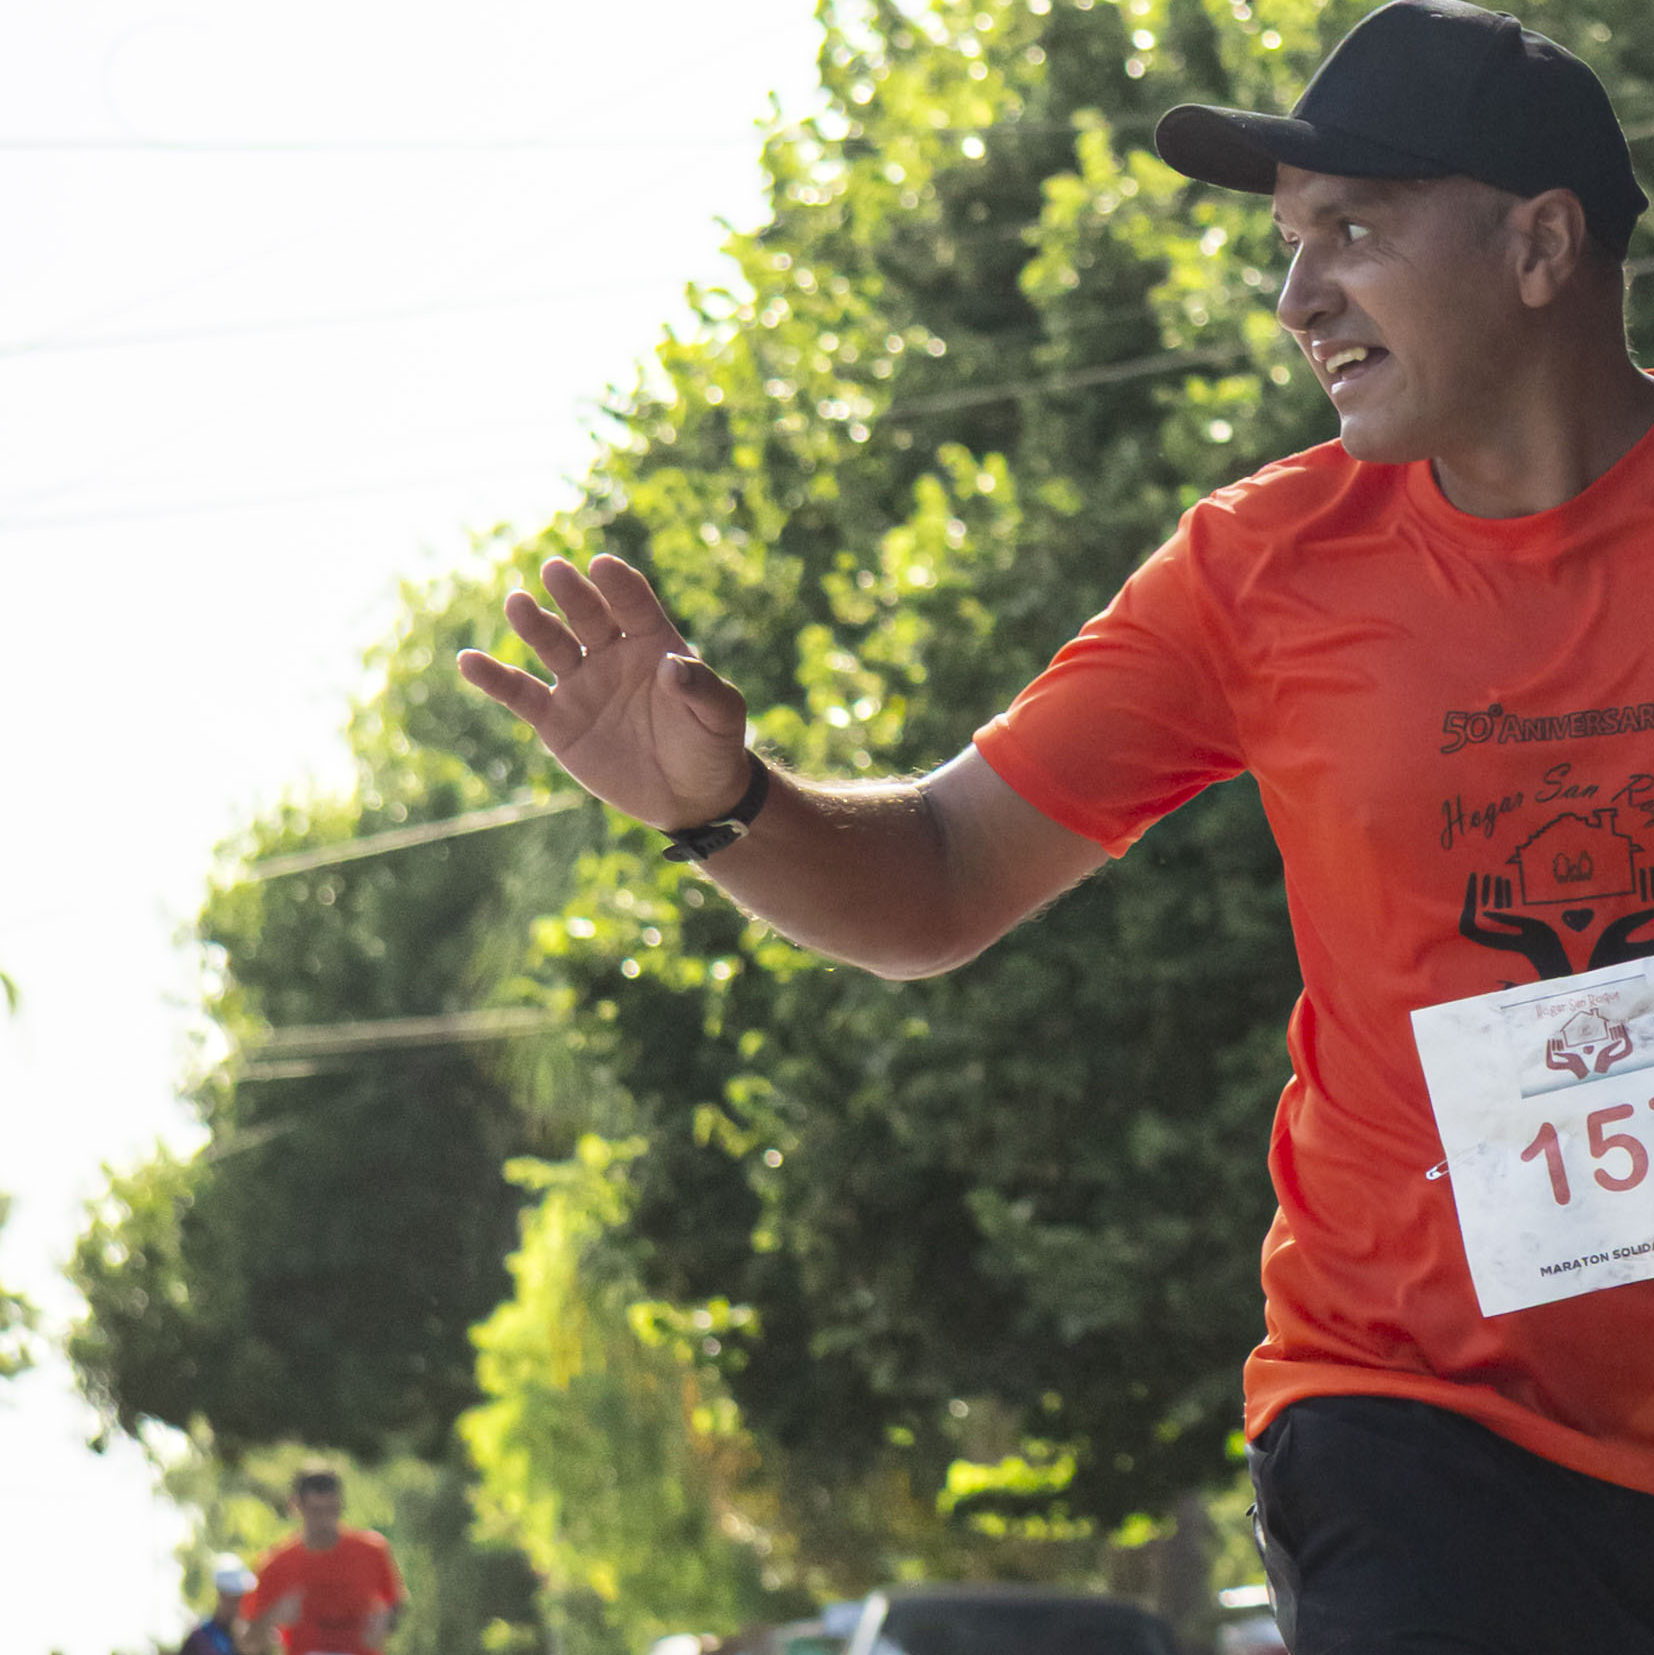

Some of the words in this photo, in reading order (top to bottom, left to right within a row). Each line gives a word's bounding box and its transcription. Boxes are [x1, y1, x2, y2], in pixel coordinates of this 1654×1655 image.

[1440, 793, 1524, 851] Hogar
[1534, 761, 1600, 803] San
[1539, 1252, 1609, 1277] MARATON
